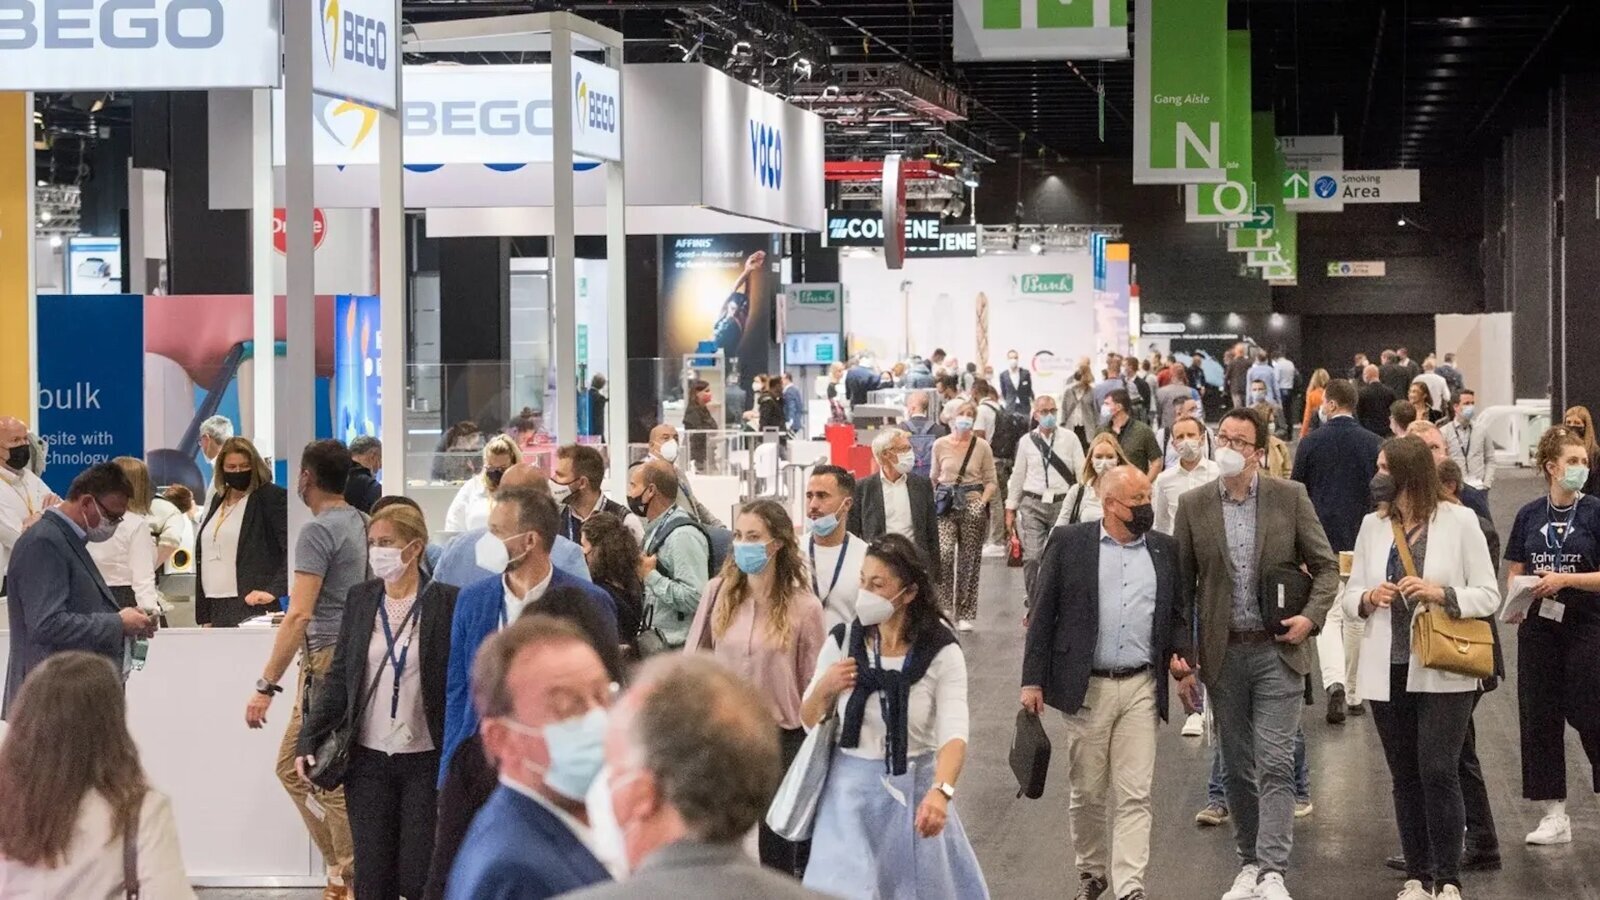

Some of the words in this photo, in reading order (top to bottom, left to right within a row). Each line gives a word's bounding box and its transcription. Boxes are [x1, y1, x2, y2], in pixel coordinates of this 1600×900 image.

[0, 0, 224, 49] BEGO
[343, 10, 387, 71] BEGO
[588, 91, 615, 133] BEGO
[1153, 95, 1182, 106] Gang
[1184, 94, 1210, 104] Aisle
[404, 100, 552, 136] BEGO
[750, 119, 782, 191] VOCO
[1176, 121, 1219, 169] N
[1225, 161, 1239, 169] isle
[1342, 174, 1381, 184] Smoking
[1213, 181, 1248, 215] O
[1342, 185, 1381, 198] Area
[848, 218, 939, 239] COLENE
[675, 238, 712, 248] AFFINIS
[38, 382, 101, 410] bulk
[41, 430, 77, 445] osite
[81, 430, 113, 445] with
[45, 450, 109, 465] chnology
